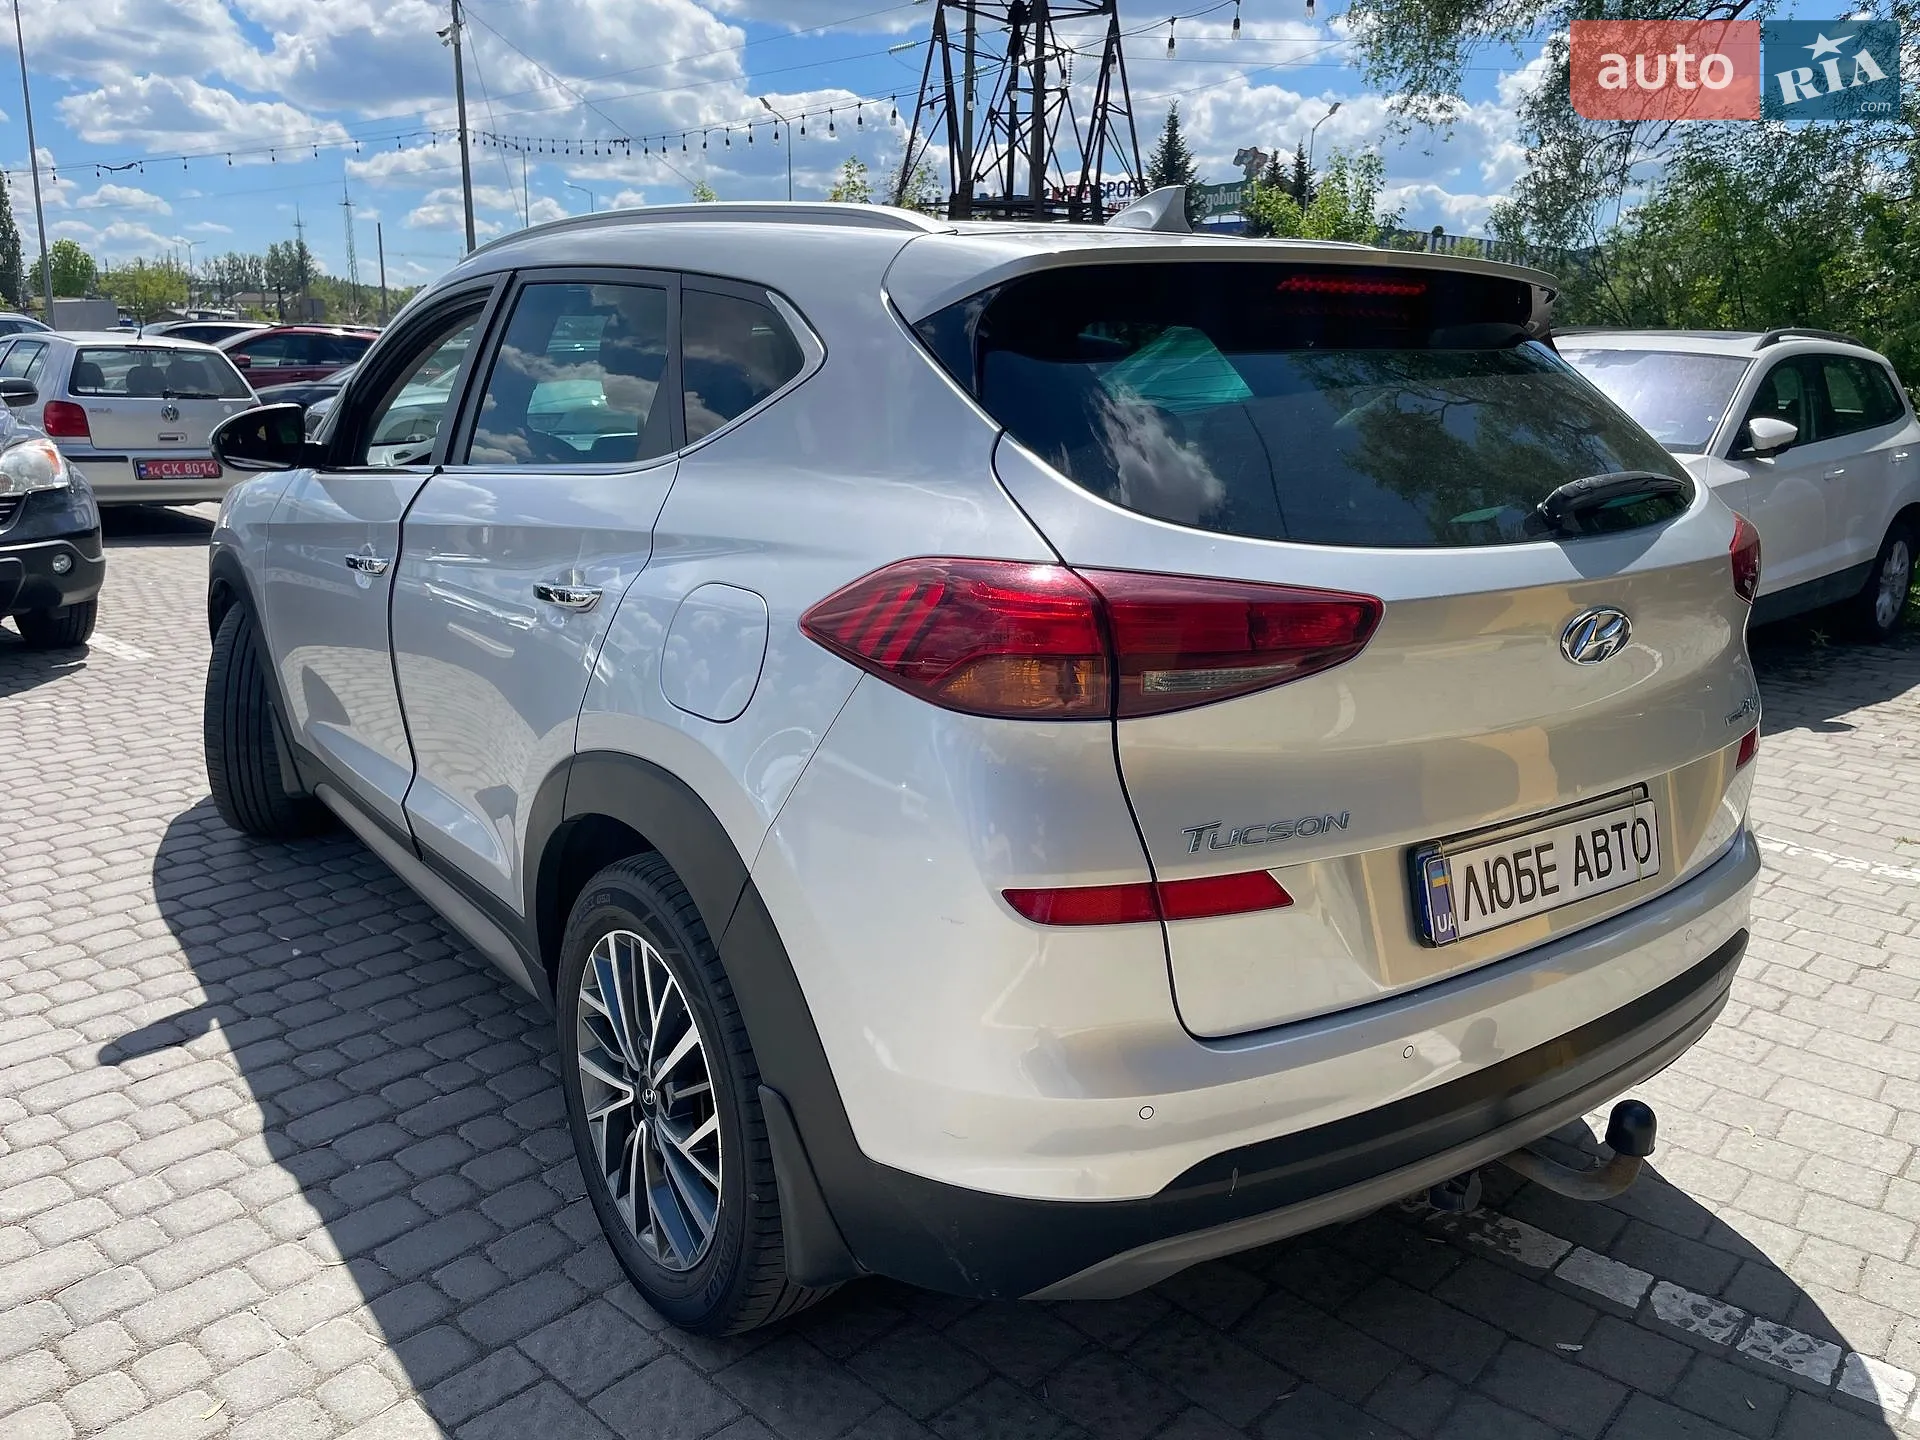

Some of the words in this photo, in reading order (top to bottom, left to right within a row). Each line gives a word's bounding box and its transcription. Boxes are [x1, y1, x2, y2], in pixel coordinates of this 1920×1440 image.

[148, 466, 160, 475] 14
[185, 462, 215, 475] 8014
[1181, 810, 1351, 855] TUCSON
[1463, 841, 1560, 922] ЛЮБЕ
[1574, 817, 1652, 887] АВТО
[1437, 911, 1457, 933] UA
